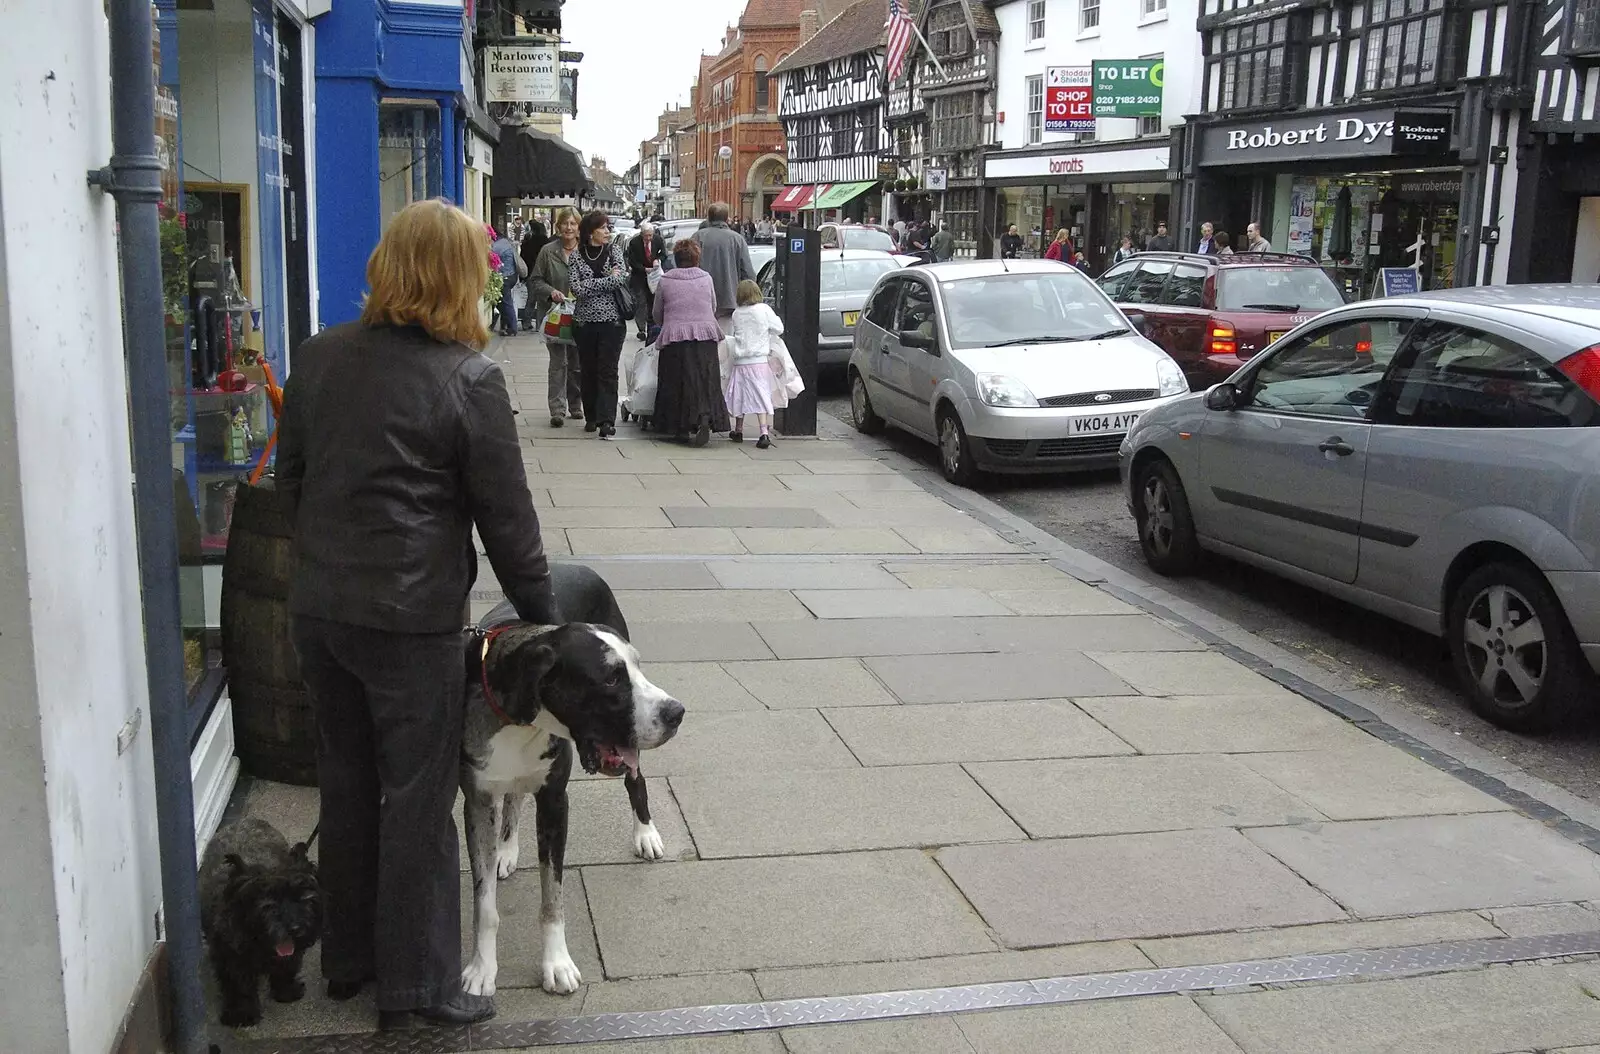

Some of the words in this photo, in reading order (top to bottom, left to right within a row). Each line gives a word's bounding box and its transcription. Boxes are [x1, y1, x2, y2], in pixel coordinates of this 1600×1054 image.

[492, 51, 552, 61] Marlowe's
[491, 63, 553, 73] Restaurant
[1060, 69, 1092, 77] Stoddar
[1098, 67, 1118, 80] TO
[1122, 67, 1148, 80] LET
[1056, 91, 1088, 102] SHOP
[1096, 96, 1113, 104] 020
[1115, 96, 1135, 104] 7182
[1048, 103, 1067, 115] TO
[1070, 103, 1092, 114] LET
[1226, 122, 1327, 150] Robert
[1335, 118, 1395, 143] Dya
[1400, 125, 1446, 134] Robert
[1405, 133, 1439, 142] Dyas
[1049, 158, 1084, 173] barratts
[794, 241, 802, 251] P
[1074, 417, 1110, 432] VK04
